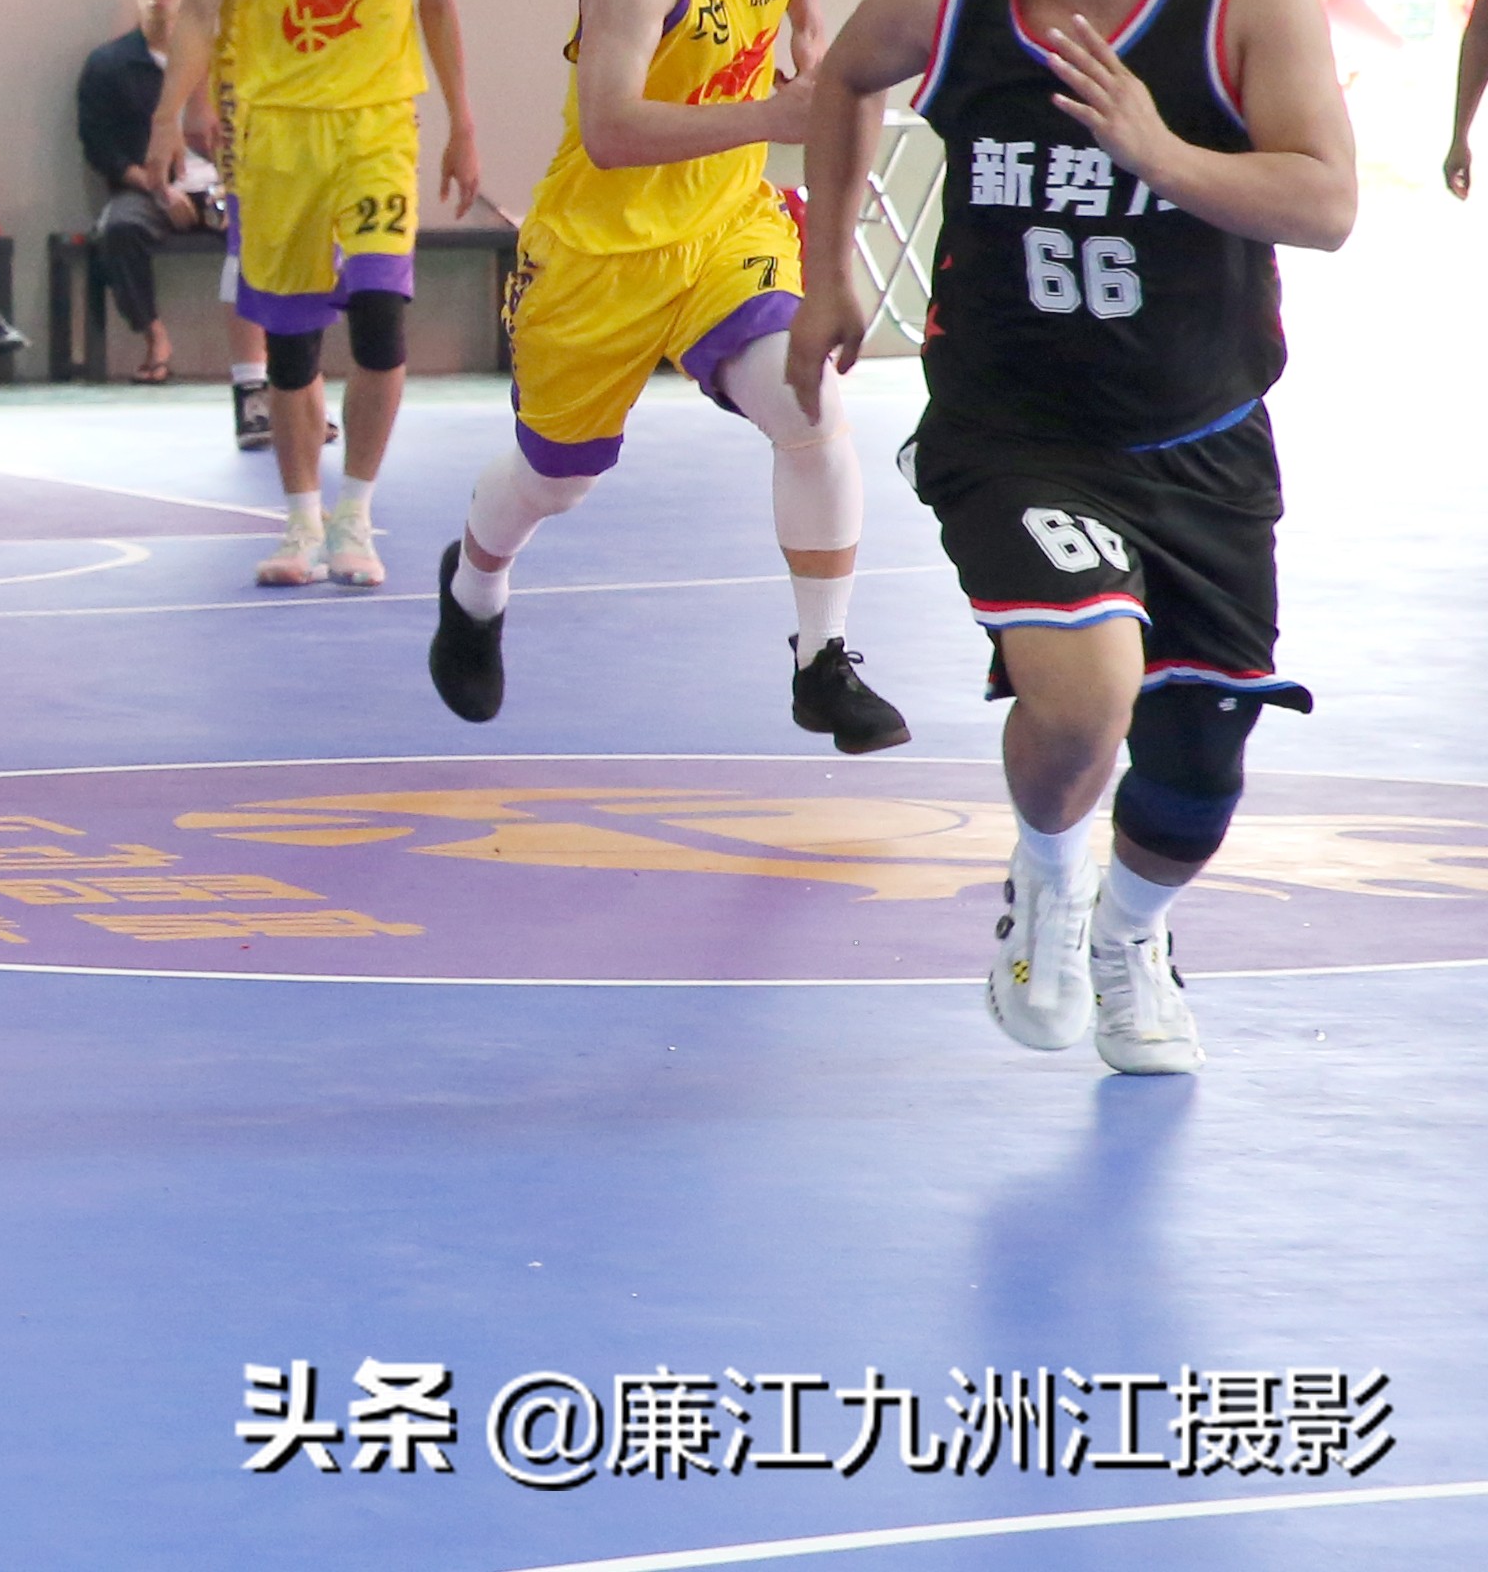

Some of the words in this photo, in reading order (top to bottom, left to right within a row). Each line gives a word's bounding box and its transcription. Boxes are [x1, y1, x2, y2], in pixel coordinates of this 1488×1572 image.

[355, 193, 409, 237] 22
[743, 255, 779, 291] 7
[1023, 225, 1144, 321] 66
[1021, 506, 1131, 575] 66
